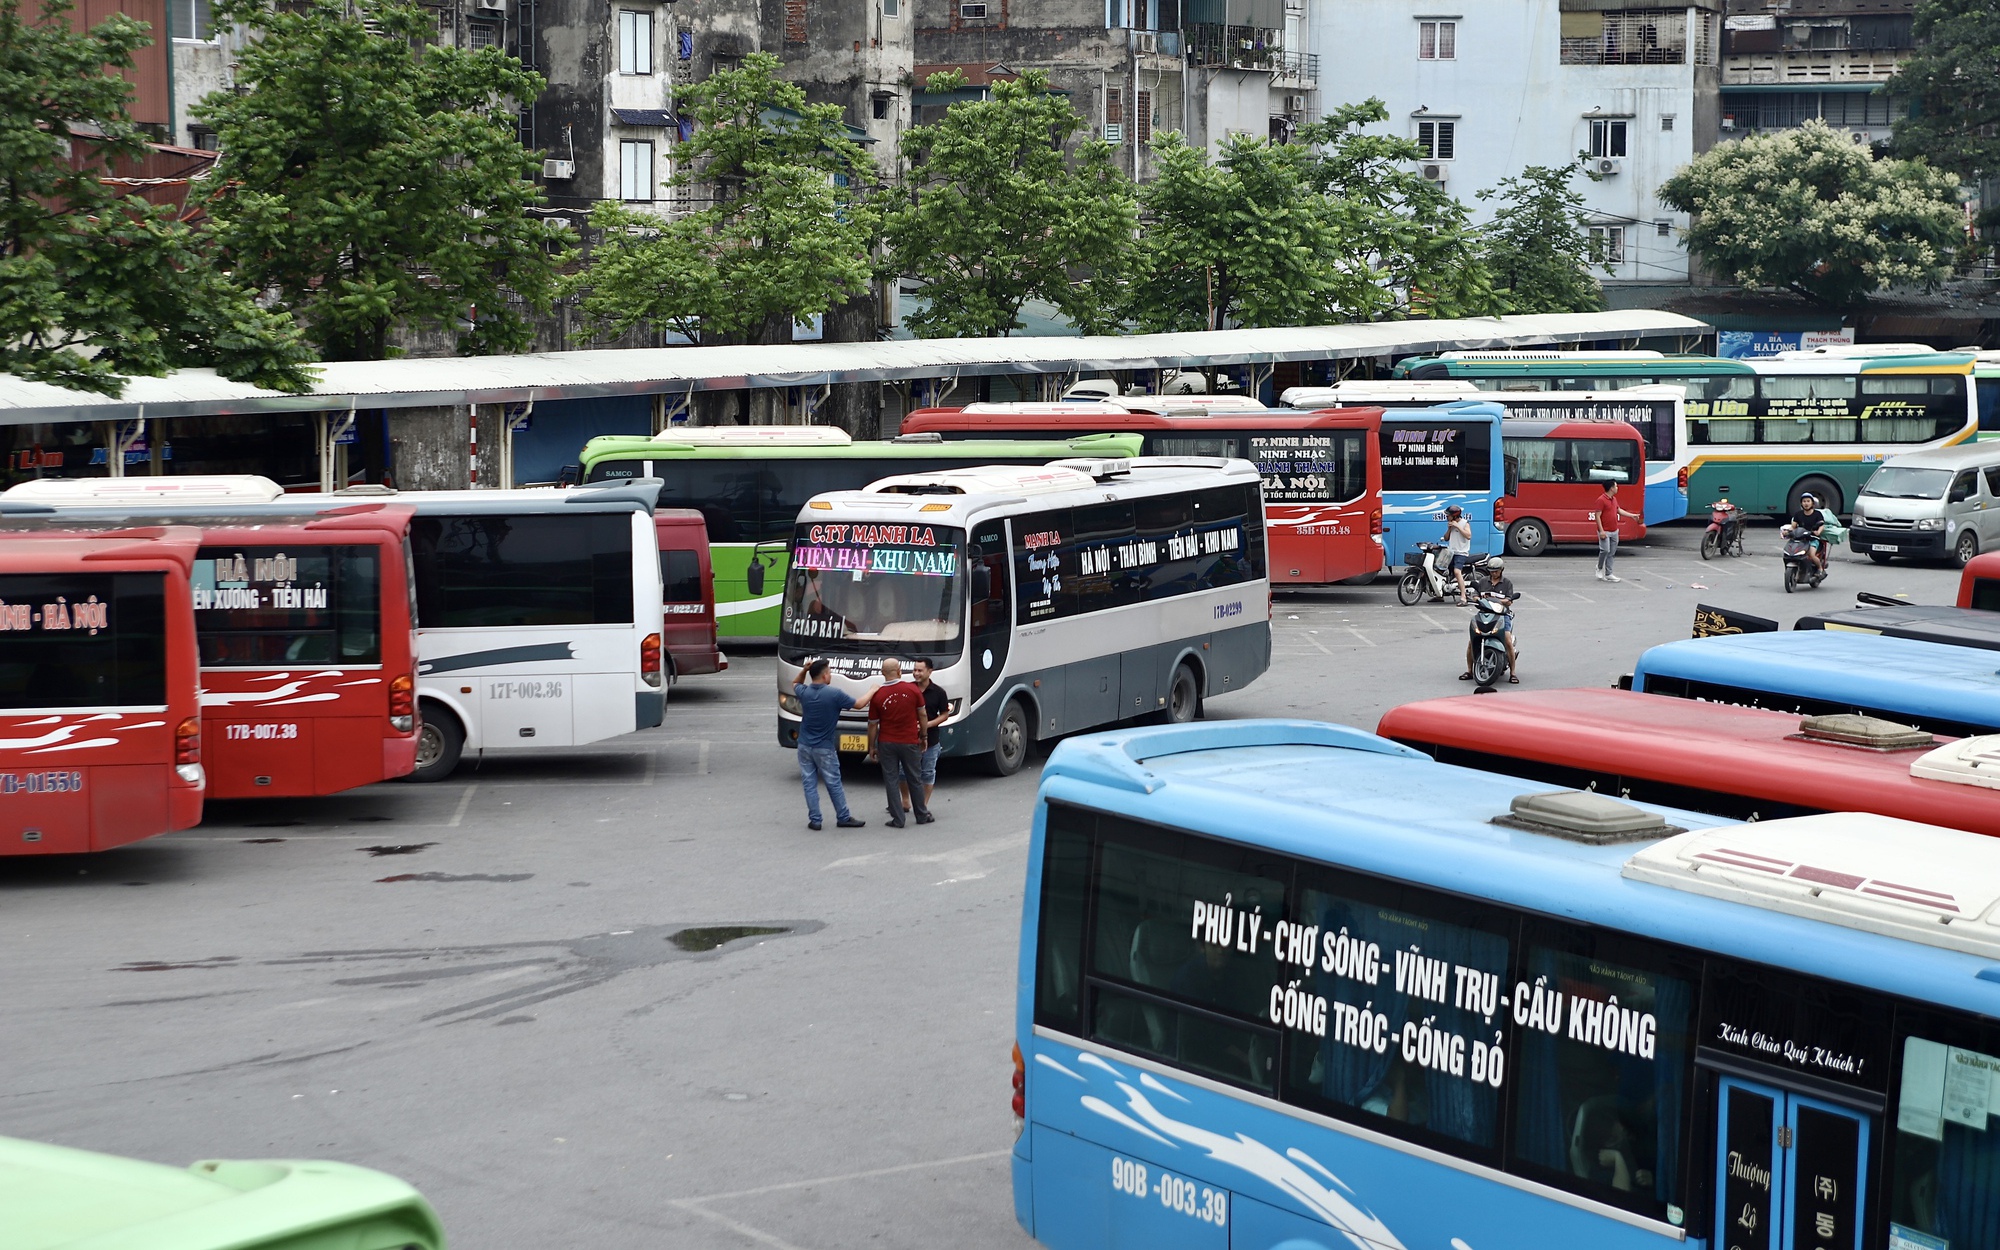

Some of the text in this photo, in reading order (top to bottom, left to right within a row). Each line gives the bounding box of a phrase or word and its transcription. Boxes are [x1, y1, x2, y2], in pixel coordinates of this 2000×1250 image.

[1711, 400, 1749, 416] Liên
[1269, 437, 1299, 447] NINH
[1302, 434, 1331, 447] BÌNH
[1398, 443, 1444, 453] TP NINH BÌNH
[1259, 450, 1288, 459] NINH
[1289, 473, 1327, 492] NỘI
[810, 525, 936, 547] C.TY MẠNH LA
[1049, 530, 1061, 546] LA
[871, 549, 909, 572] KHU
[912, 551, 955, 574] NAM
[1081, 546, 1094, 576] HÀ
[1095, 543, 1111, 577] NỘI
[1118, 539, 1138, 569] THÁI
[1138, 538, 1157, 566] BÌNH
[1186, 527, 1199, 558] HẢI
[1204, 531, 1220, 554] KHU
[1221, 528, 1239, 553] NAM
[216, 552, 298, 588] HÀ NỘI
[214, 586, 260, 610] XƯƠNG
[304, 582, 327, 609] HẢI
[43, 596, 71, 630] HÀ
[73, 595, 108, 636] NỘI
[490, 681, 562, 699] 17F-002.36
[225, 724, 298, 740] 17B-007.38
[1192, 892, 1233, 948] PHỦ
[1236, 905, 1262, 954] LÝ
[1274, 919, 1318, 977] CHỢ
[1321, 926, 1380, 985] SÔNG
[1395, 944, 1448, 1003] VĨNH
[1454, 964, 1498, 1025] TRỤ
[1513, 974, 1562, 1034] CẦU
[1568, 994, 1656, 1060] KHÔNG
[1269, 979, 1327, 1037] CỐNG
[1333, 1000, 1388, 1054] TRÓC
[1402, 1015, 1464, 1077] CỐNG
[1471, 1030, 1504, 1088] ĐỎ
[1716, 1022, 1748, 1046] Kính
[1751, 1031, 1781, 1054] Chào
[1783, 1039, 1809, 1064] Quý
[1809, 1046, 1854, 1073] Khách
[1112, 1156, 1148, 1199] 90B
[1728, 1150, 1770, 1192] Thượng
[1737, 1202, 1757, 1236] Lộ
